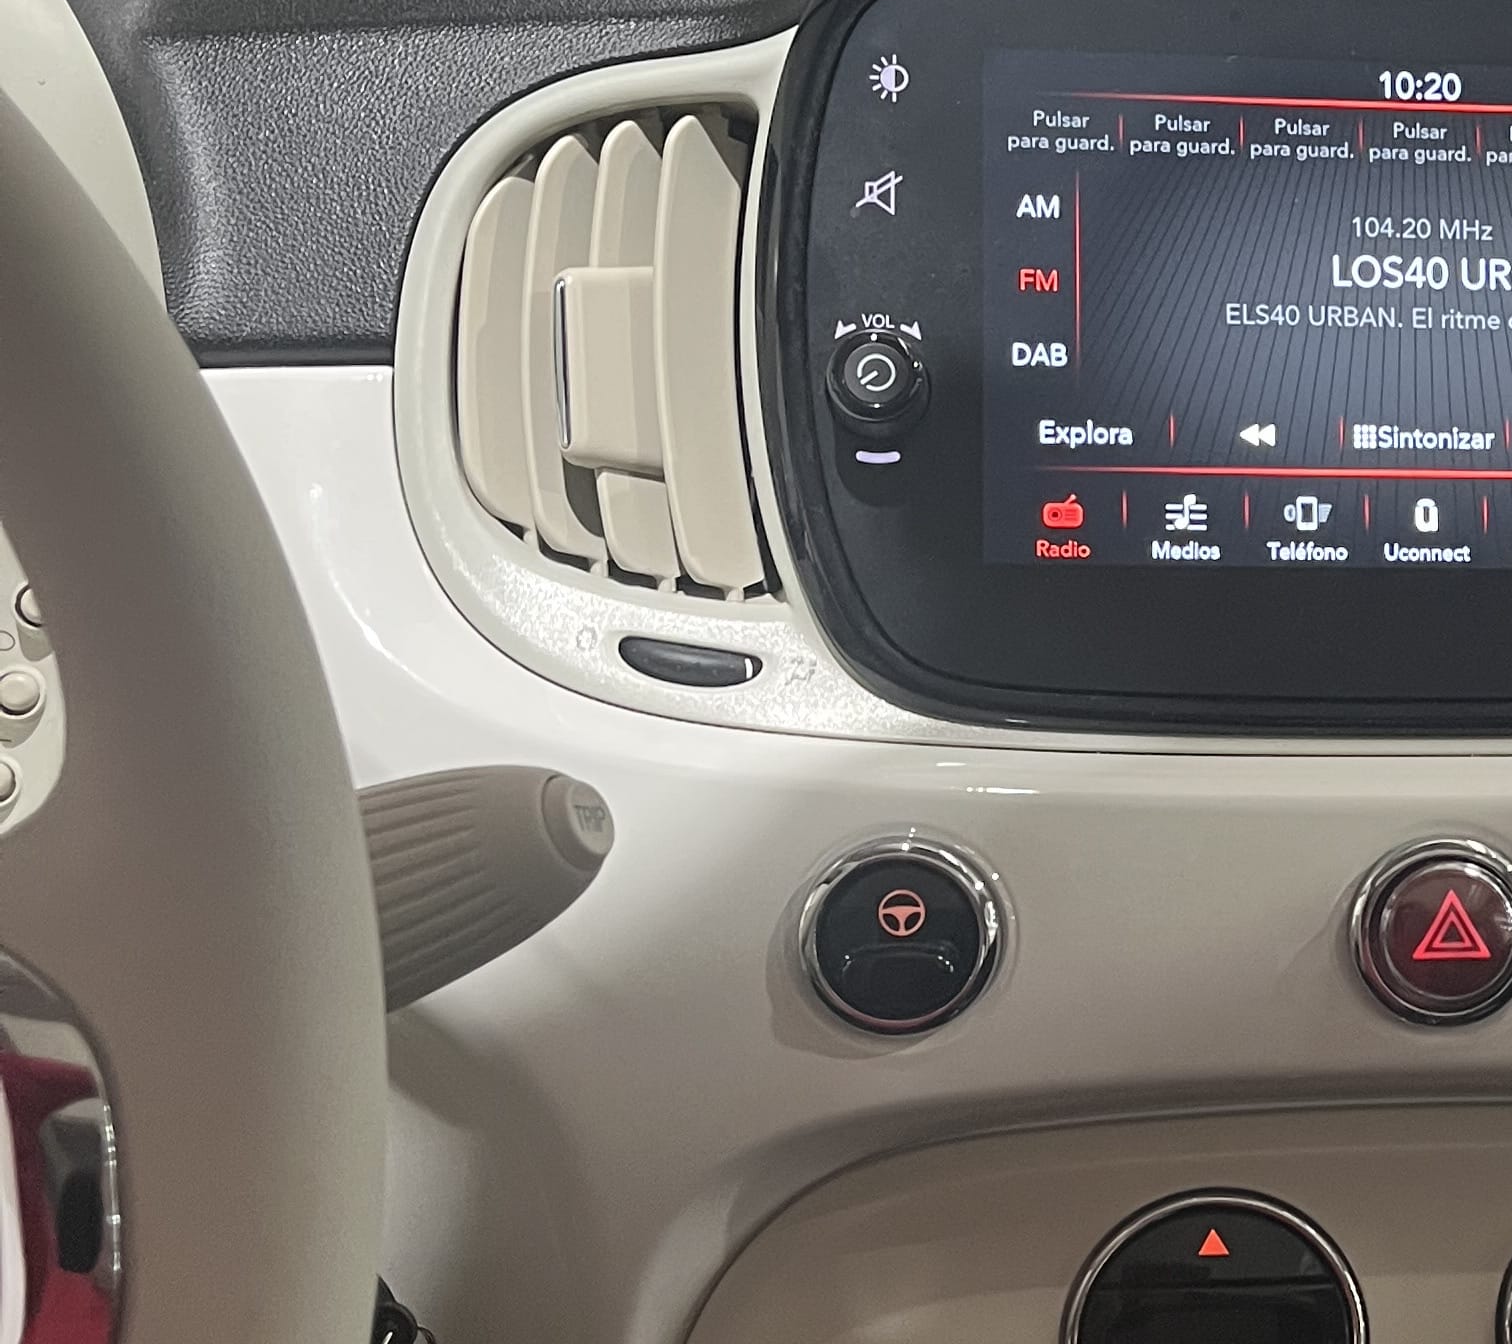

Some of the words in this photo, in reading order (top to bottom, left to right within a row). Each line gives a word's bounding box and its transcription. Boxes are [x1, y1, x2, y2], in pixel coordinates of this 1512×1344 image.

[1379, 71, 1461, 101] 10:20
[1034, 110, 1089, 127] Pulsar
[1156, 114, 1210, 131] Pulsar
[1275, 119, 1329, 135] Pulsar
[1394, 122, 1447, 139] Pulsar
[1008, 137, 1049, 151] para
[1055, 135, 1114, 153] guard.
[1130, 141, 1170, 155] para
[1177, 138, 1234, 157] guard.
[1251, 144, 1290, 159] para
[1297, 142, 1353, 160] guard.
[1370, 148, 1408, 162] para
[1415, 146, 1471, 164] guard.
[1017, 195, 1059, 218] AM
[1353, 217, 1431, 238] 104.20
[1440, 219, 1492, 240] MHz
[1021, 269, 1057, 291] FM
[1333, 255, 1448, 289] LOS40
[1461, 258, 1511, 290] UR
[862, 314, 894, 328] VOL
[1227, 304, 1299, 325] ELS40
[1309, 306, 1402, 327] URBAN.
[1413, 307, 1432, 328] El
[1442, 309, 1500, 329] ritme
[1013, 343, 1067, 366] DAB
[1039, 420, 1133, 448] Explora
[1379, 425, 1495, 449] Sintonizar
[1037, 540, 1090, 557] Radio
[1152, 541, 1220, 559] Medios
[1267, 542, 1348, 560] Teléfono
[1384, 543, 1470, 562] Uconnect
[574, 805, 606, 832] TRIP
